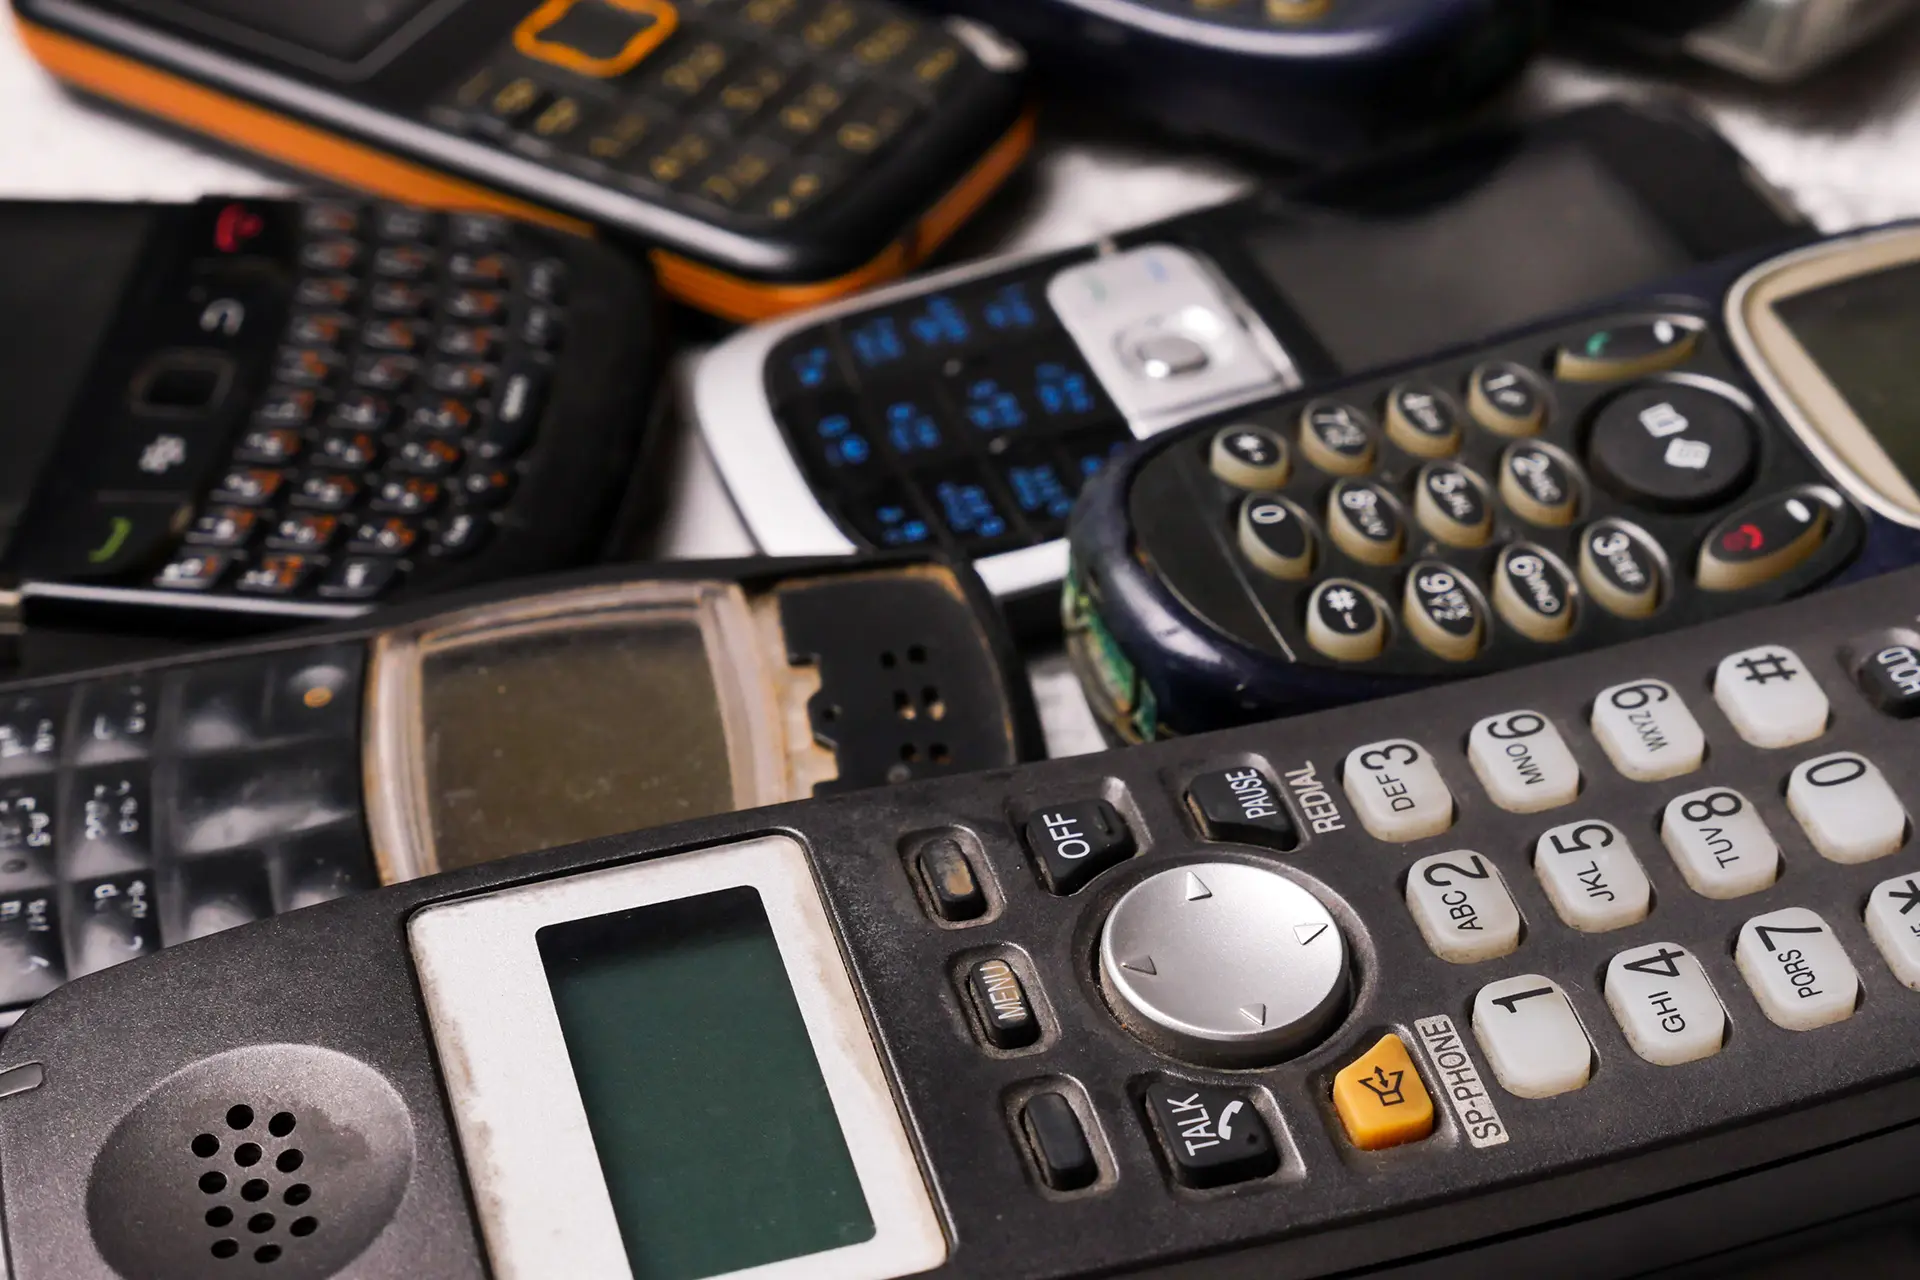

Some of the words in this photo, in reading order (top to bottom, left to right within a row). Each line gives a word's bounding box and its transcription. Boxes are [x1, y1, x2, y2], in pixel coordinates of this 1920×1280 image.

[1512, 453, 1549, 476] 2
[1430, 473, 1467, 494] 5
[1252, 504, 1286, 524] 0
[1343, 489, 1377, 510] 8
[1593, 532, 1630, 556] 3
[1509, 556, 1544, 576] 6
[1419, 573, 1455, 593] 9
[1736, 653, 1796, 684] #
[1611, 684, 1669, 709] 9
[1487, 714, 1545, 740] 6
[1628, 711, 1668, 752] WXYZ
[1360, 744, 1418, 771] 3
[1506, 743, 1545, 785] MNO
[1806, 758, 1866, 786] 0
[1225, 769, 1277, 819] PAUSE
[1285, 760, 1345, 834] REDIAL
[1376, 774, 1415, 811] DEF
[1681, 792, 1742, 822] 8
[1043, 813, 1090, 858] OFF
[1550, 824, 1614, 854] 5
[1699, 827, 1739, 868] TUV
[1423, 855, 1489, 887] 2
[1577, 860, 1614, 901] JKL
[1441, 890, 1483, 930] ABC
[1755, 925, 1823, 952] 7
[1623, 948, 1684, 977] 4
[1777, 949, 1823, 999] PQRS
[980, 966, 1027, 1019] MENU
[1492, 986, 1554, 1013] 1
[1648, 990, 1686, 1033] GHI
[1421, 1020, 1502, 1139] SP-PHONE
[1167, 1093, 1220, 1156] TALK
